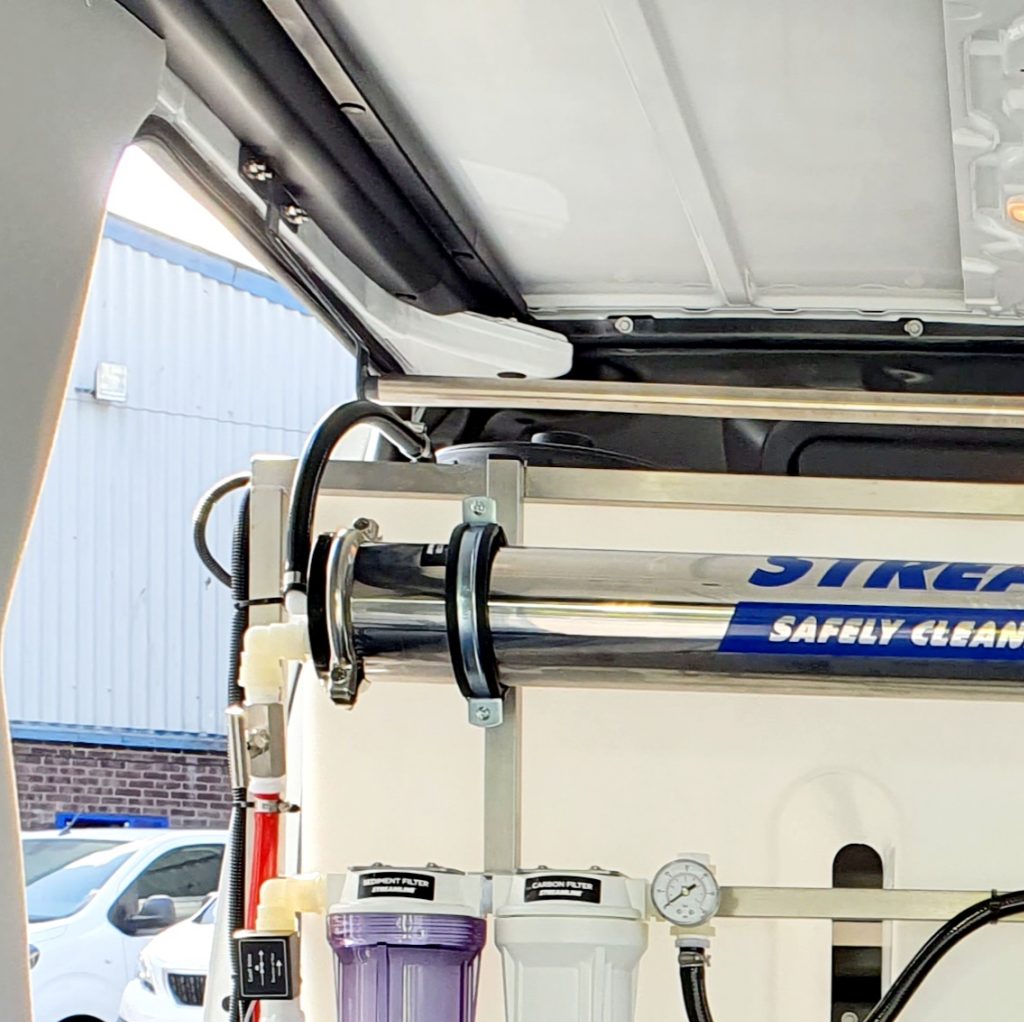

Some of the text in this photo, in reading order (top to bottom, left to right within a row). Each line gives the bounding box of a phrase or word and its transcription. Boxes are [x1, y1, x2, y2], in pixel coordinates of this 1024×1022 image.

[768, 615, 905, 645] SAFELY
[401, 877, 430, 888] FILTER
[531, 881, 594, 891] CARBON FILTER
